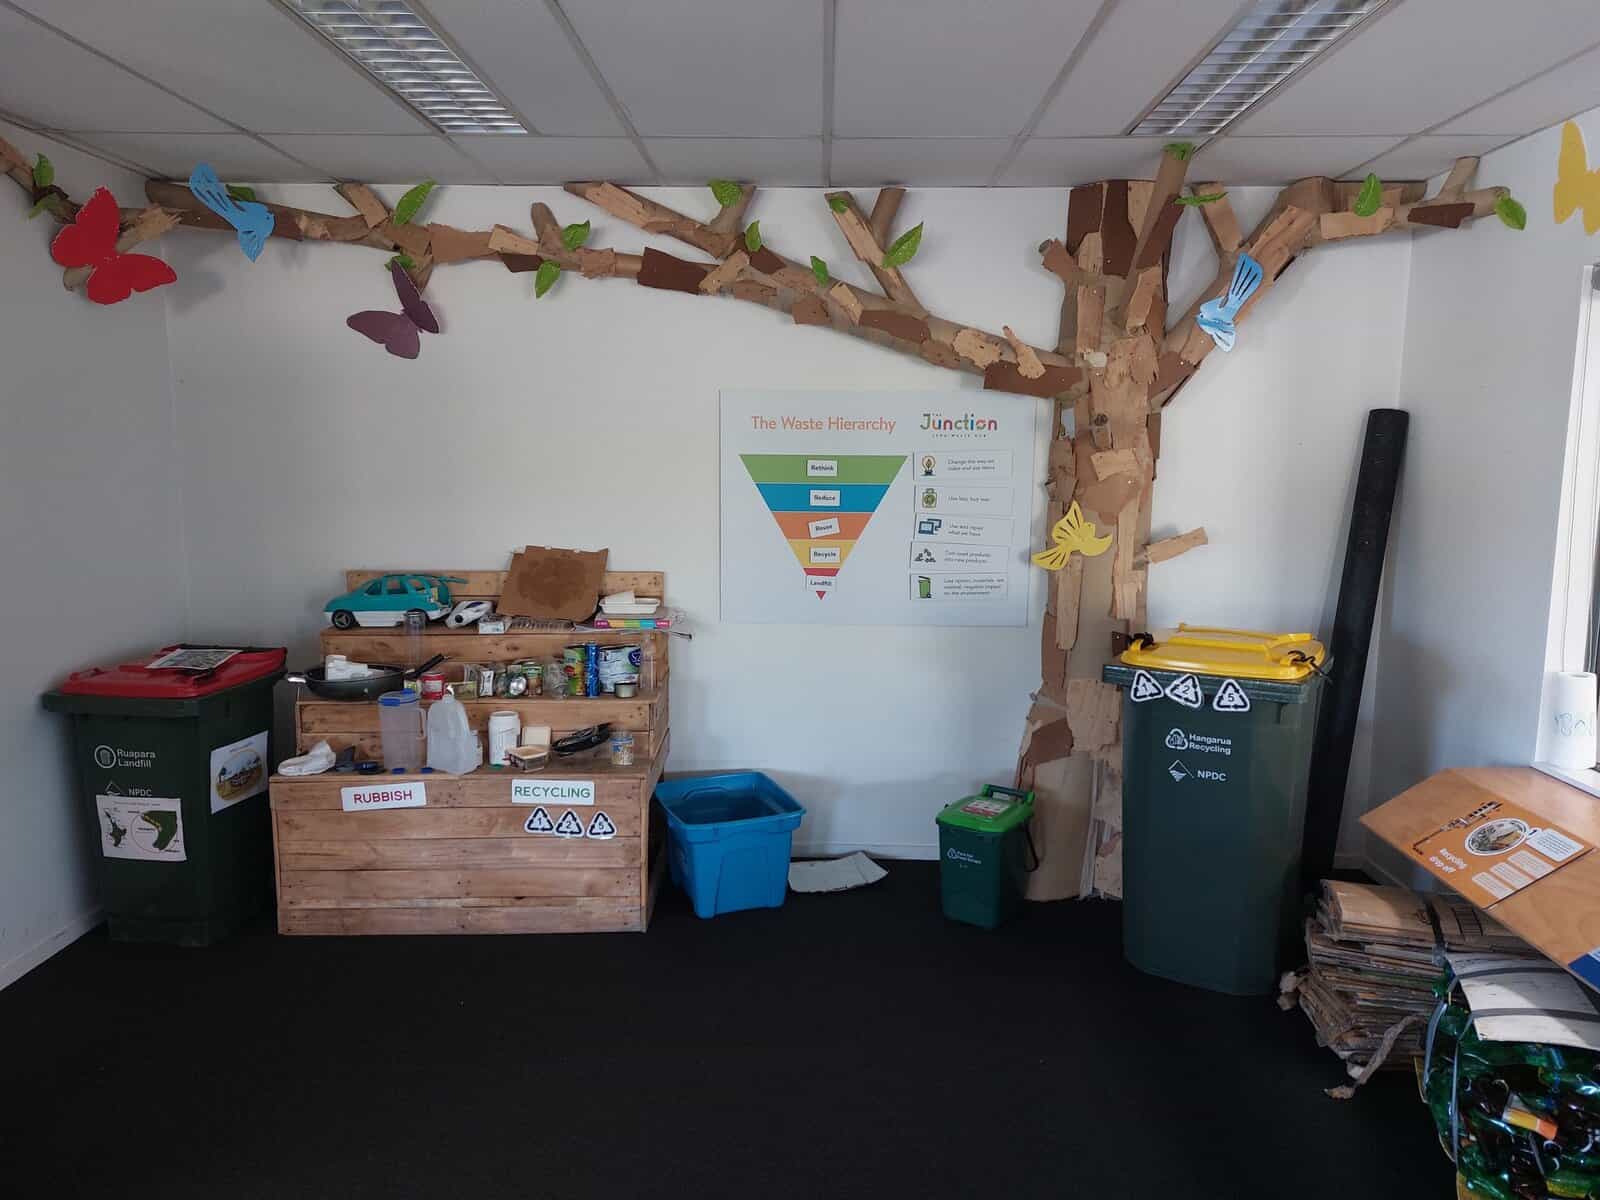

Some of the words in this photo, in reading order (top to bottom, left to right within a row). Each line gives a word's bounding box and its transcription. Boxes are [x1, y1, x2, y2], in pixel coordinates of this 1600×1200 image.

[751, 415, 776, 430] The
[780, 415, 823, 431] Waste
[828, 415, 897, 434] Hierarchy
[919, 412, 998, 431] Junction
[810, 464, 834, 472] Rethink
[815, 523, 833, 532] Reuse
[813, 551, 837, 560] Recycle
[810, 578, 832, 586] Landfill
[1142, 682, 1149, 692] 1
[1182, 684, 1189, 695] 2
[1227, 693, 1235, 702] 5
[1189, 733, 1232, 746] Hangarua
[116, 747, 156, 760] Ruapara
[1189, 742, 1232, 756] Recycling
[117, 758, 152, 769] Landfill
[1197, 769, 1227, 782] NPDC
[128, 788, 153, 797] NPDC
[353, 789, 413, 805] RUBBISH
[514, 786, 591, 799] RECYCLING
[537, 817, 543, 826] 1
[566, 820, 573, 829] 2
[598, 821, 605, 831] 5
